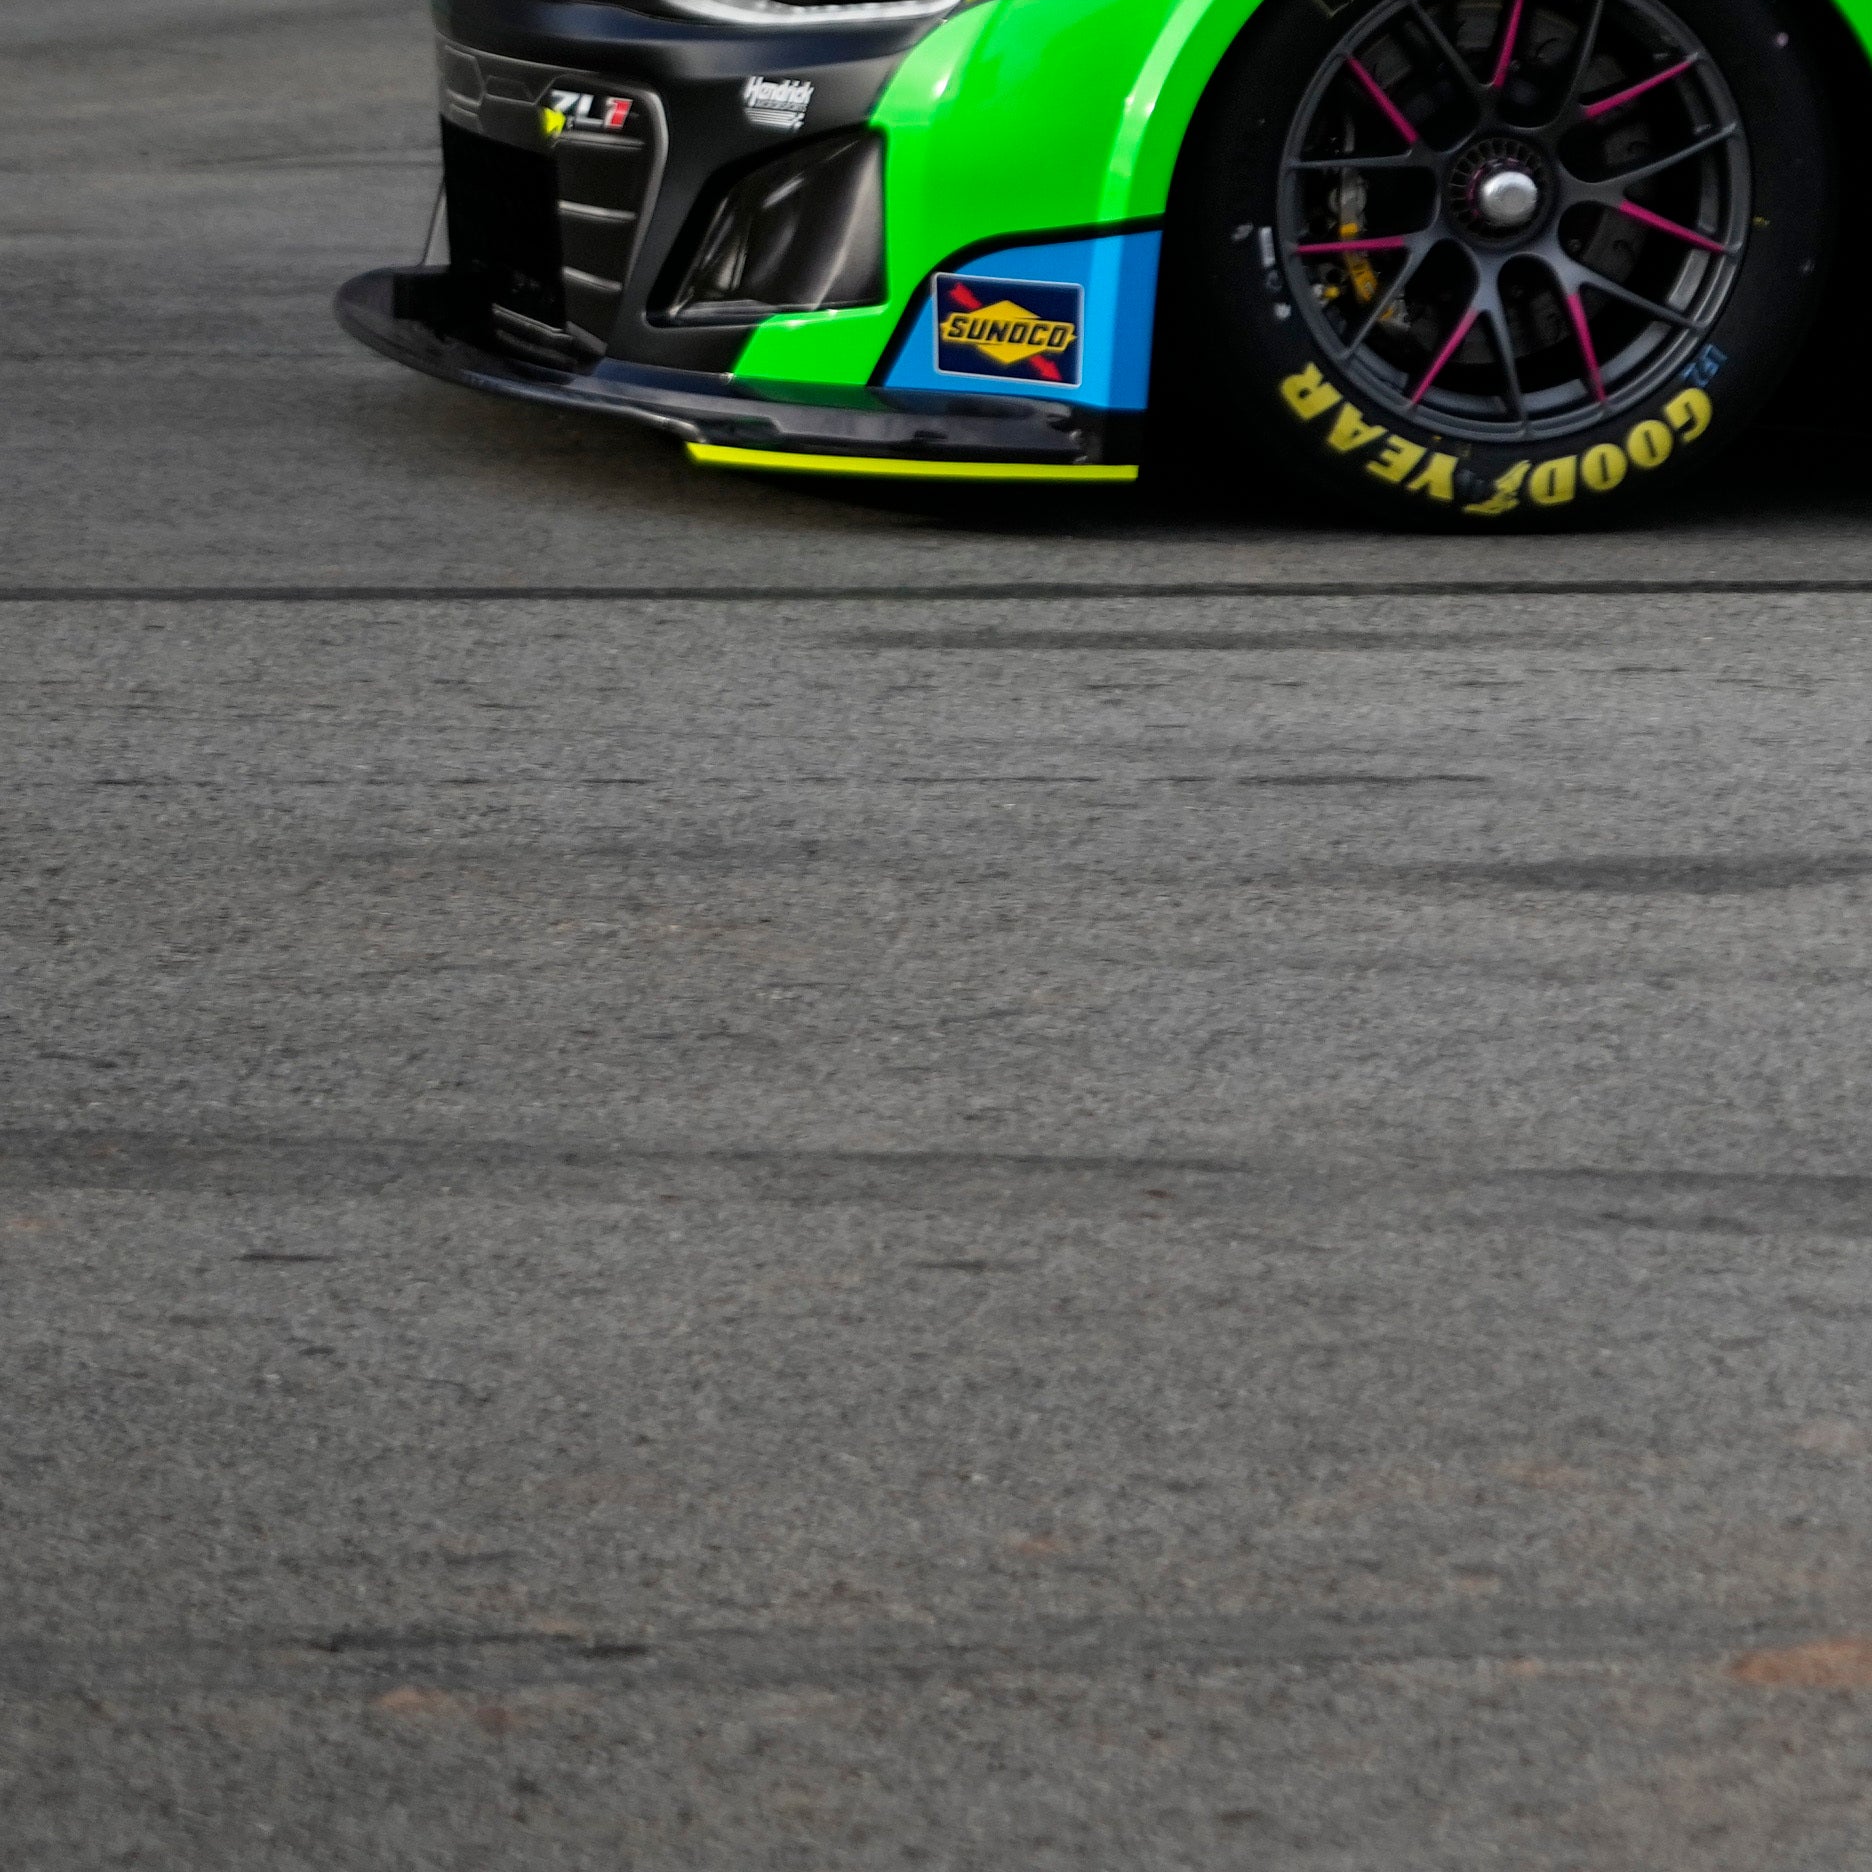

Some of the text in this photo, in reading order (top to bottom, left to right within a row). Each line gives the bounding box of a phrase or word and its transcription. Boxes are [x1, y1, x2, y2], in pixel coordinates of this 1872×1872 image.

[743, 75, 815, 108] Hendrick
[946, 313, 1069, 349] SUNOCO
[1278, 361, 1713, 516] GOODYEAR
